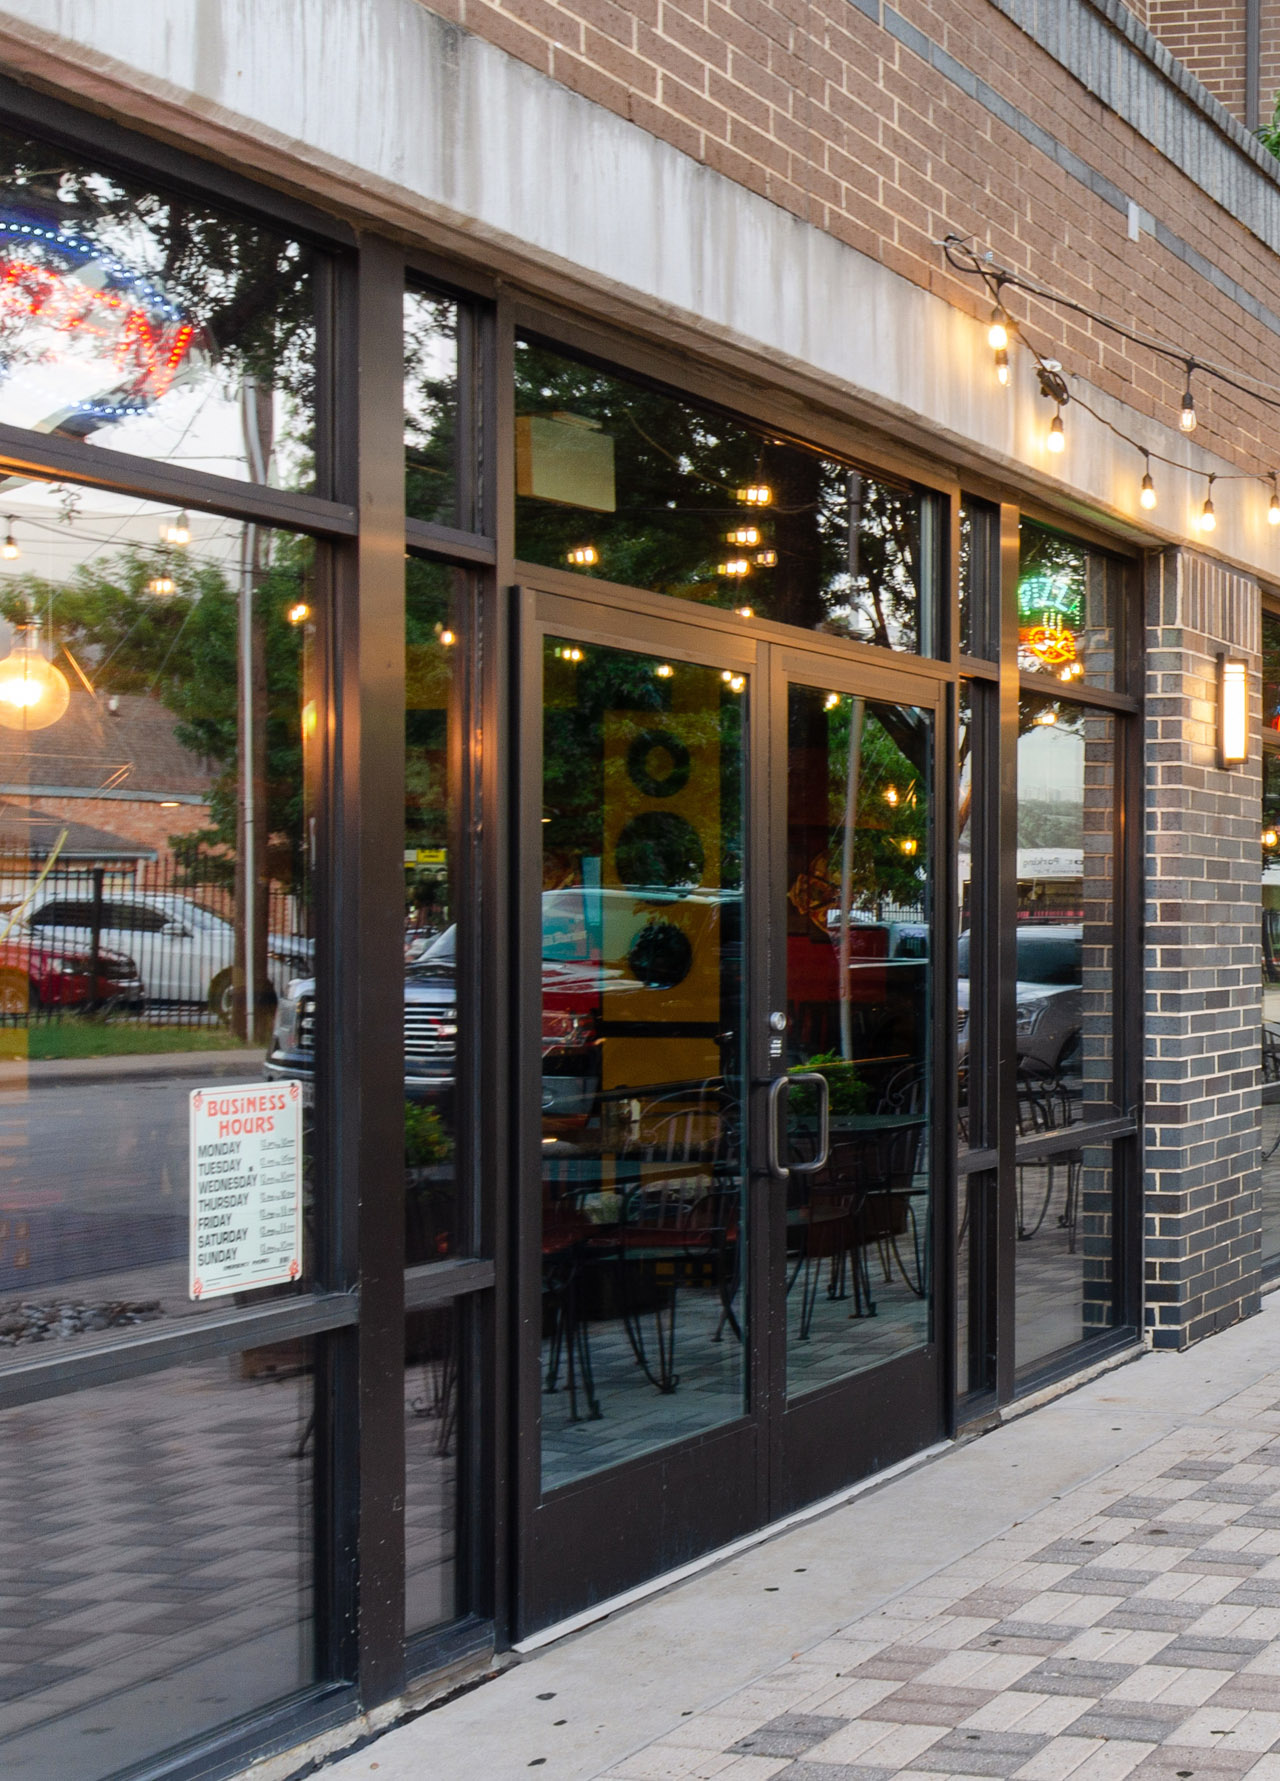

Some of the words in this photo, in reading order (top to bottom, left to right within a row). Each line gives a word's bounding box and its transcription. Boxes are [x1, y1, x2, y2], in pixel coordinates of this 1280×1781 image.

[219, 1116, 275, 1139] HOURS
[198, 1141, 242, 1158] MONDAY
[198, 1159, 242, 1176] TUESDAY
[198, 1174, 258, 1194] WEDNESDAY
[198, 1192, 249, 1212] THURSDAY
[198, 1213, 232, 1231] FRIDAY
[198, 1228, 249, 1249] SATURDAY
[198, 1247, 238, 1267] SUNDAY
